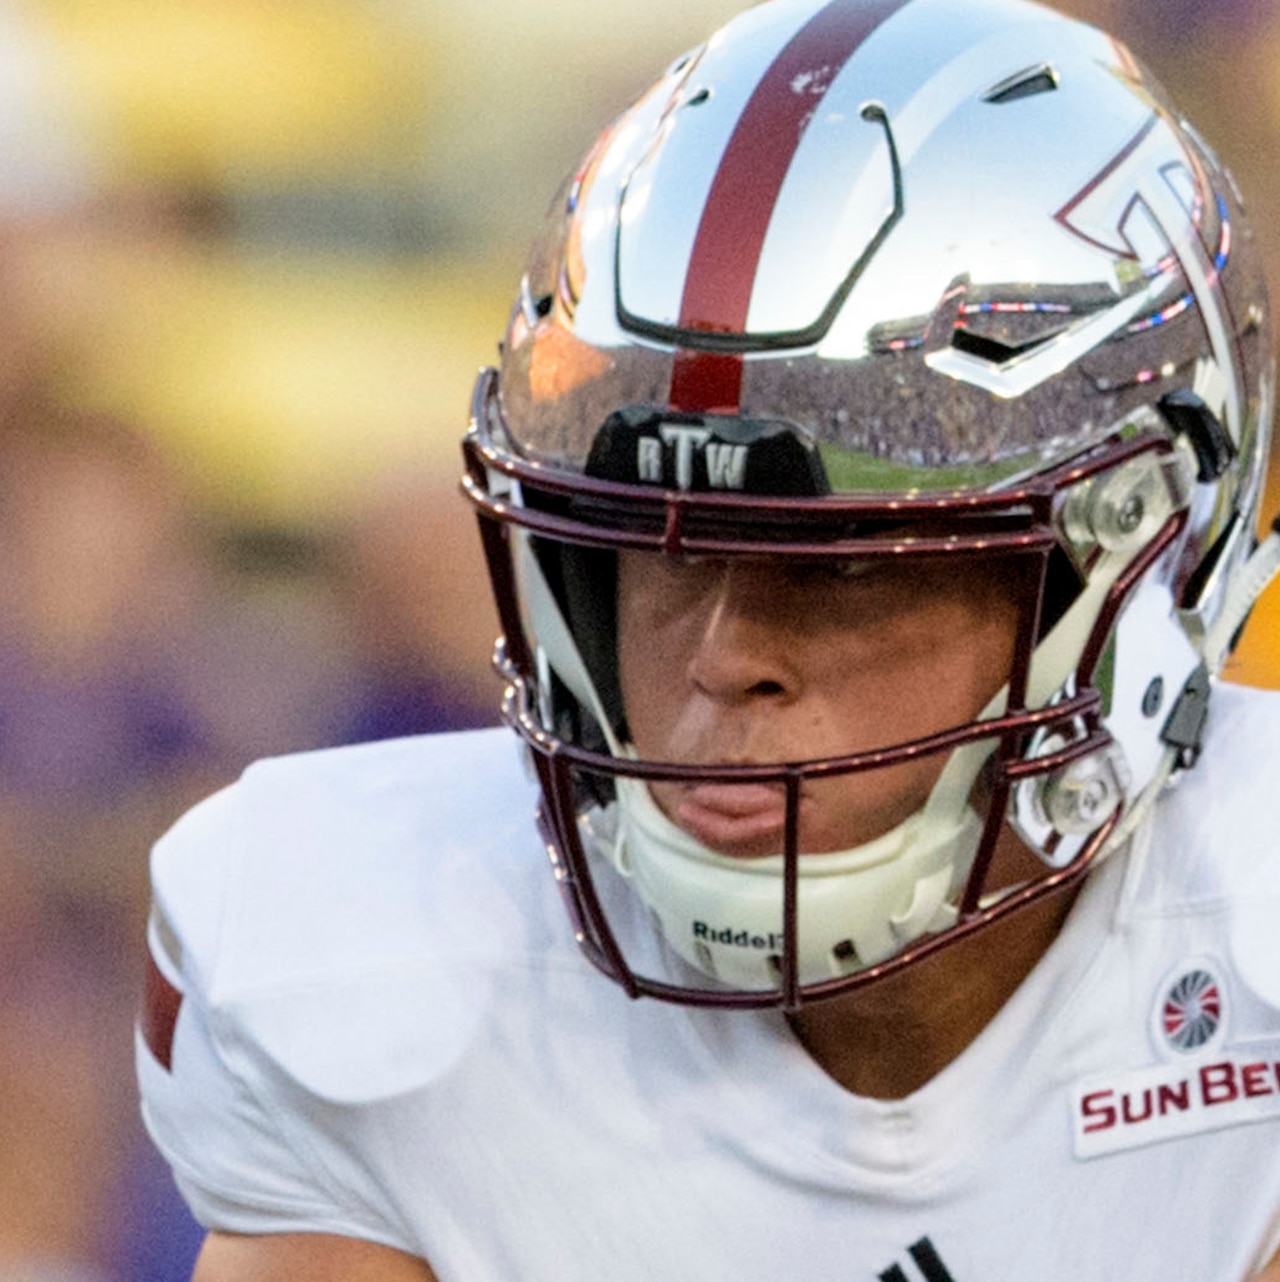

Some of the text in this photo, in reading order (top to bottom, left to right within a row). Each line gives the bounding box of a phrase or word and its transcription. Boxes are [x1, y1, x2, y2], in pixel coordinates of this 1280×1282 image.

[637, 423, 749, 490] RTW
[693, 920, 784, 950] Riddel
[1081, 1079, 1191, 1134] SUN
